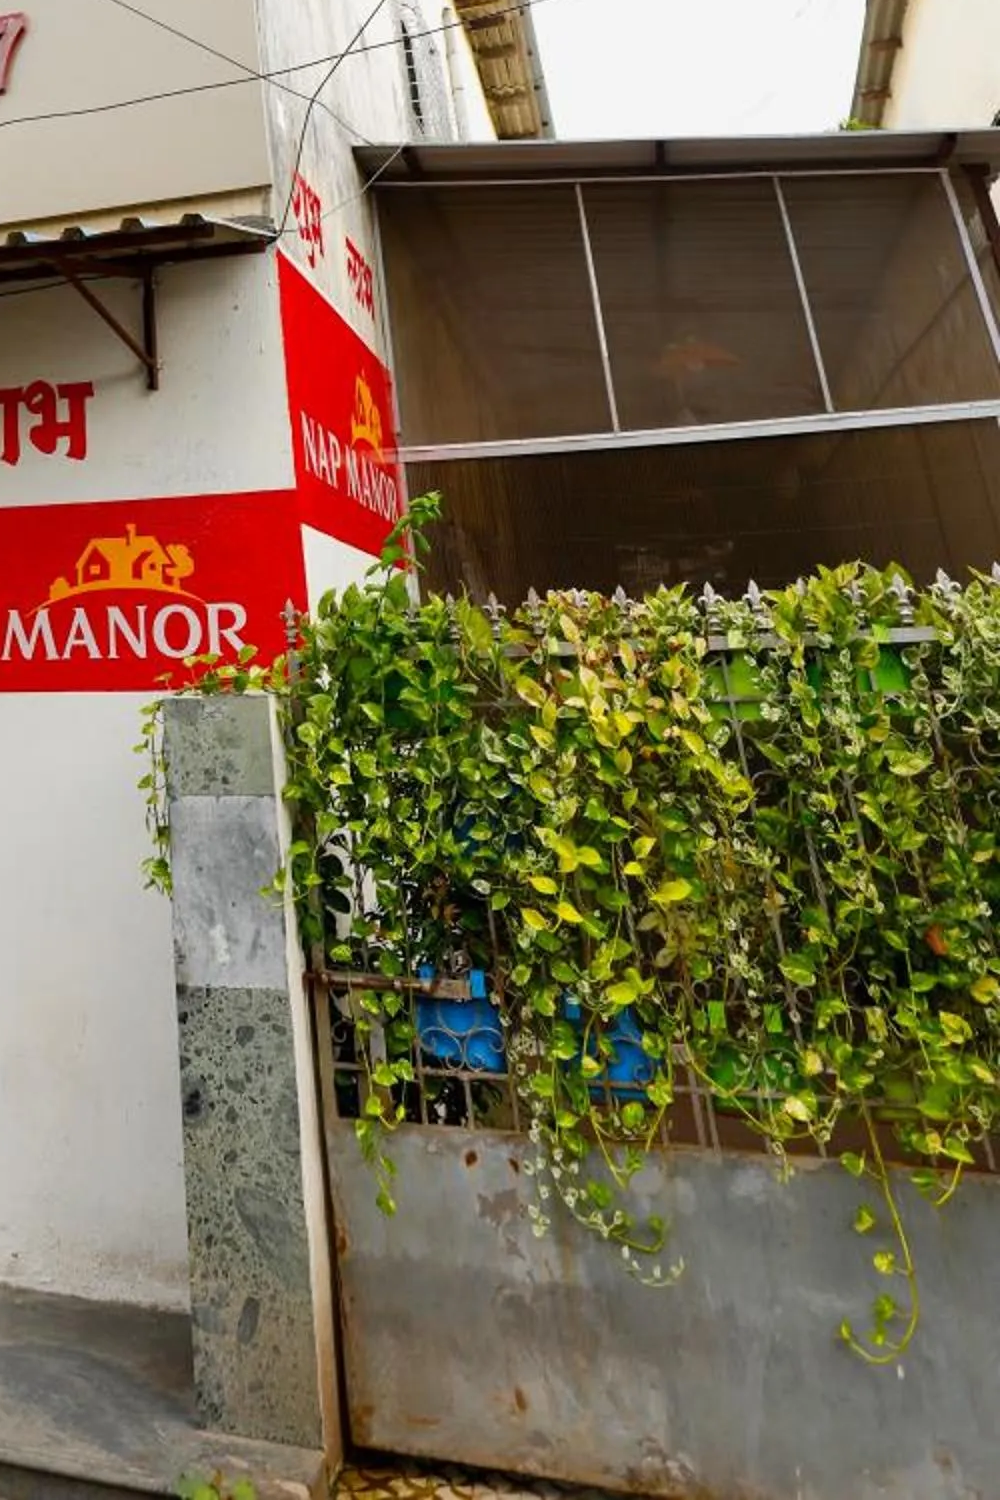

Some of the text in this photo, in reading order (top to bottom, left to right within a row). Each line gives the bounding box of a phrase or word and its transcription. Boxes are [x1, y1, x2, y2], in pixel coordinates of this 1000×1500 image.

[300, 410, 399, 524] NAP MANOR
[1, 602, 249, 661] MANOR
